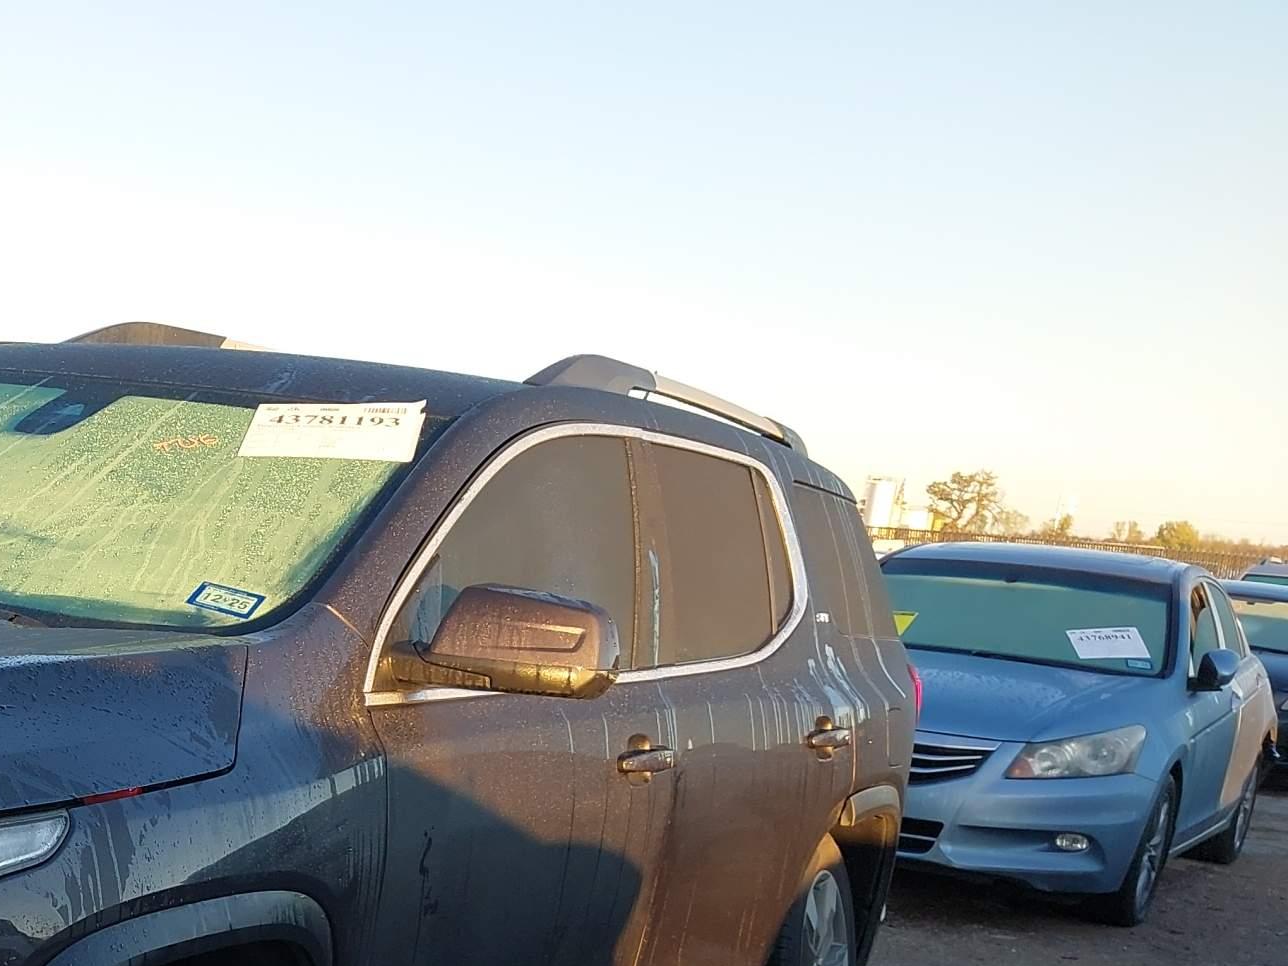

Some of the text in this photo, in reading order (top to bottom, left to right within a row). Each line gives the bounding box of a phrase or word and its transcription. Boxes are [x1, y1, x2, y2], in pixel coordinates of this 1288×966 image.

[269, 414, 400, 427] 43781193
[203, 592, 251, 610] 12 25
